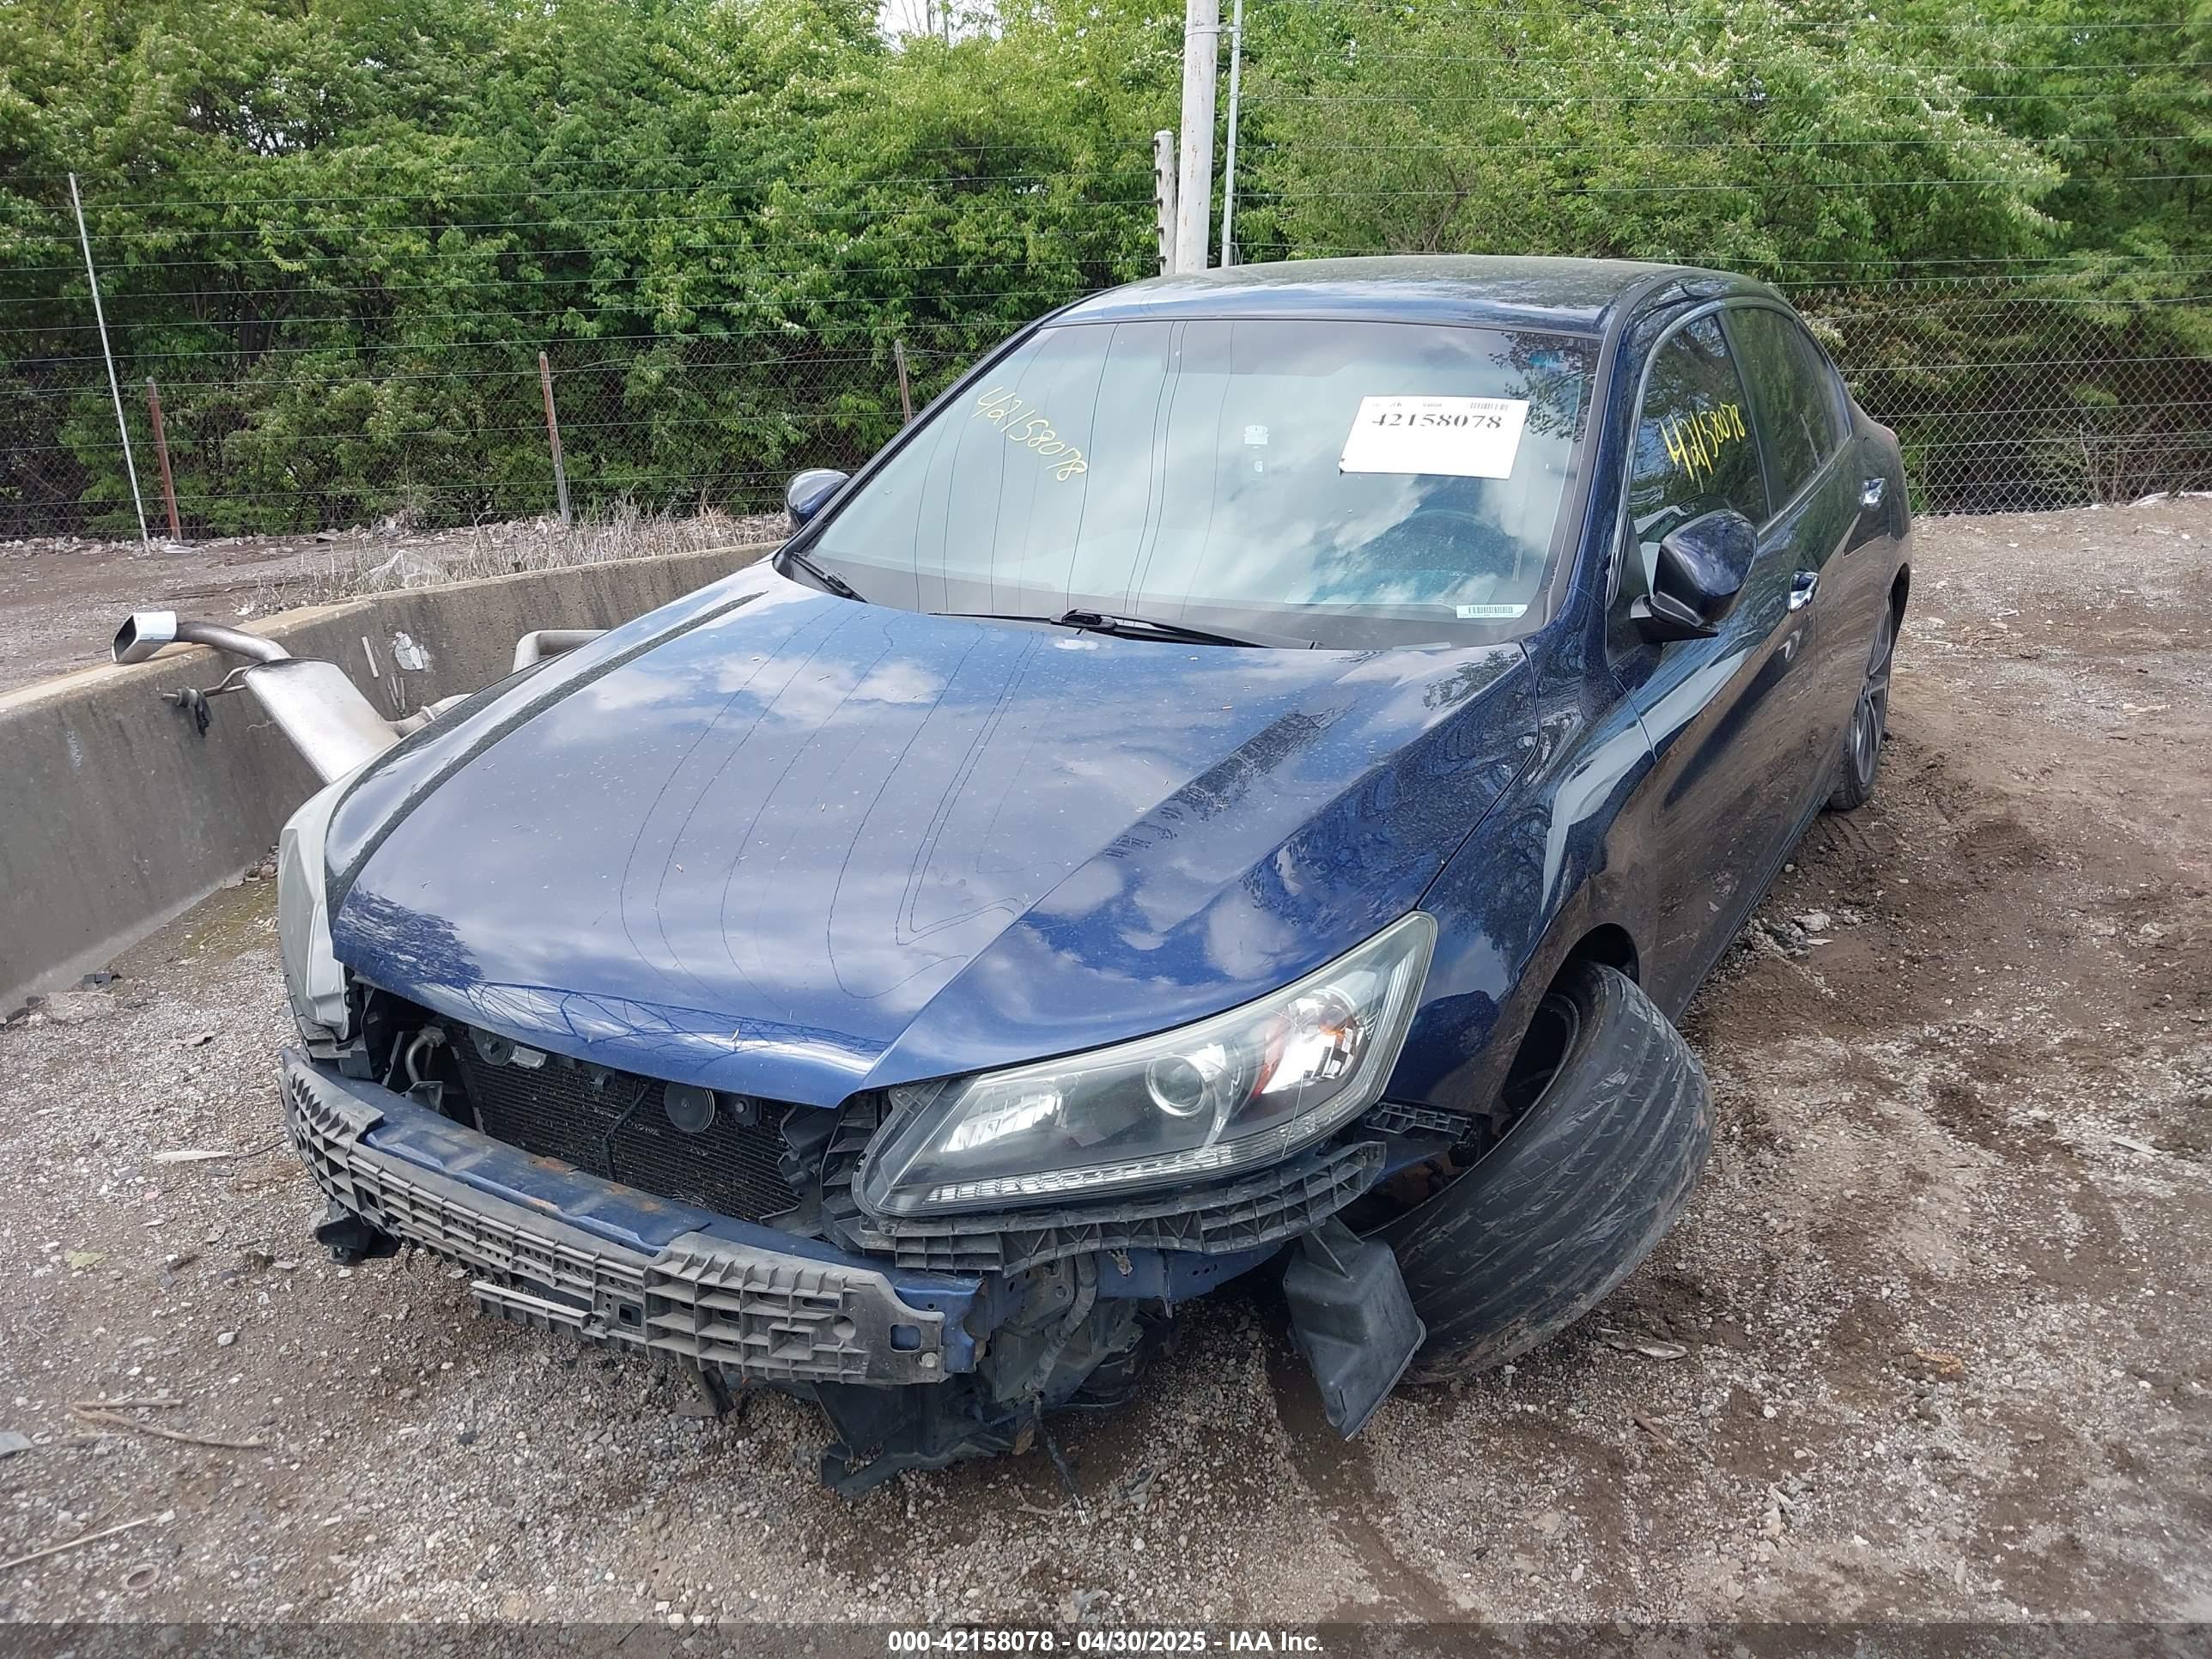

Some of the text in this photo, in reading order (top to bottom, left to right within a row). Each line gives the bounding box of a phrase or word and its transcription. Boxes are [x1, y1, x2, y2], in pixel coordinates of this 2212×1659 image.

[971, 386, 1088, 482] 42158078
[1372, 413, 1502, 429] 42158078
[1659, 401, 1746, 483] 42158078
